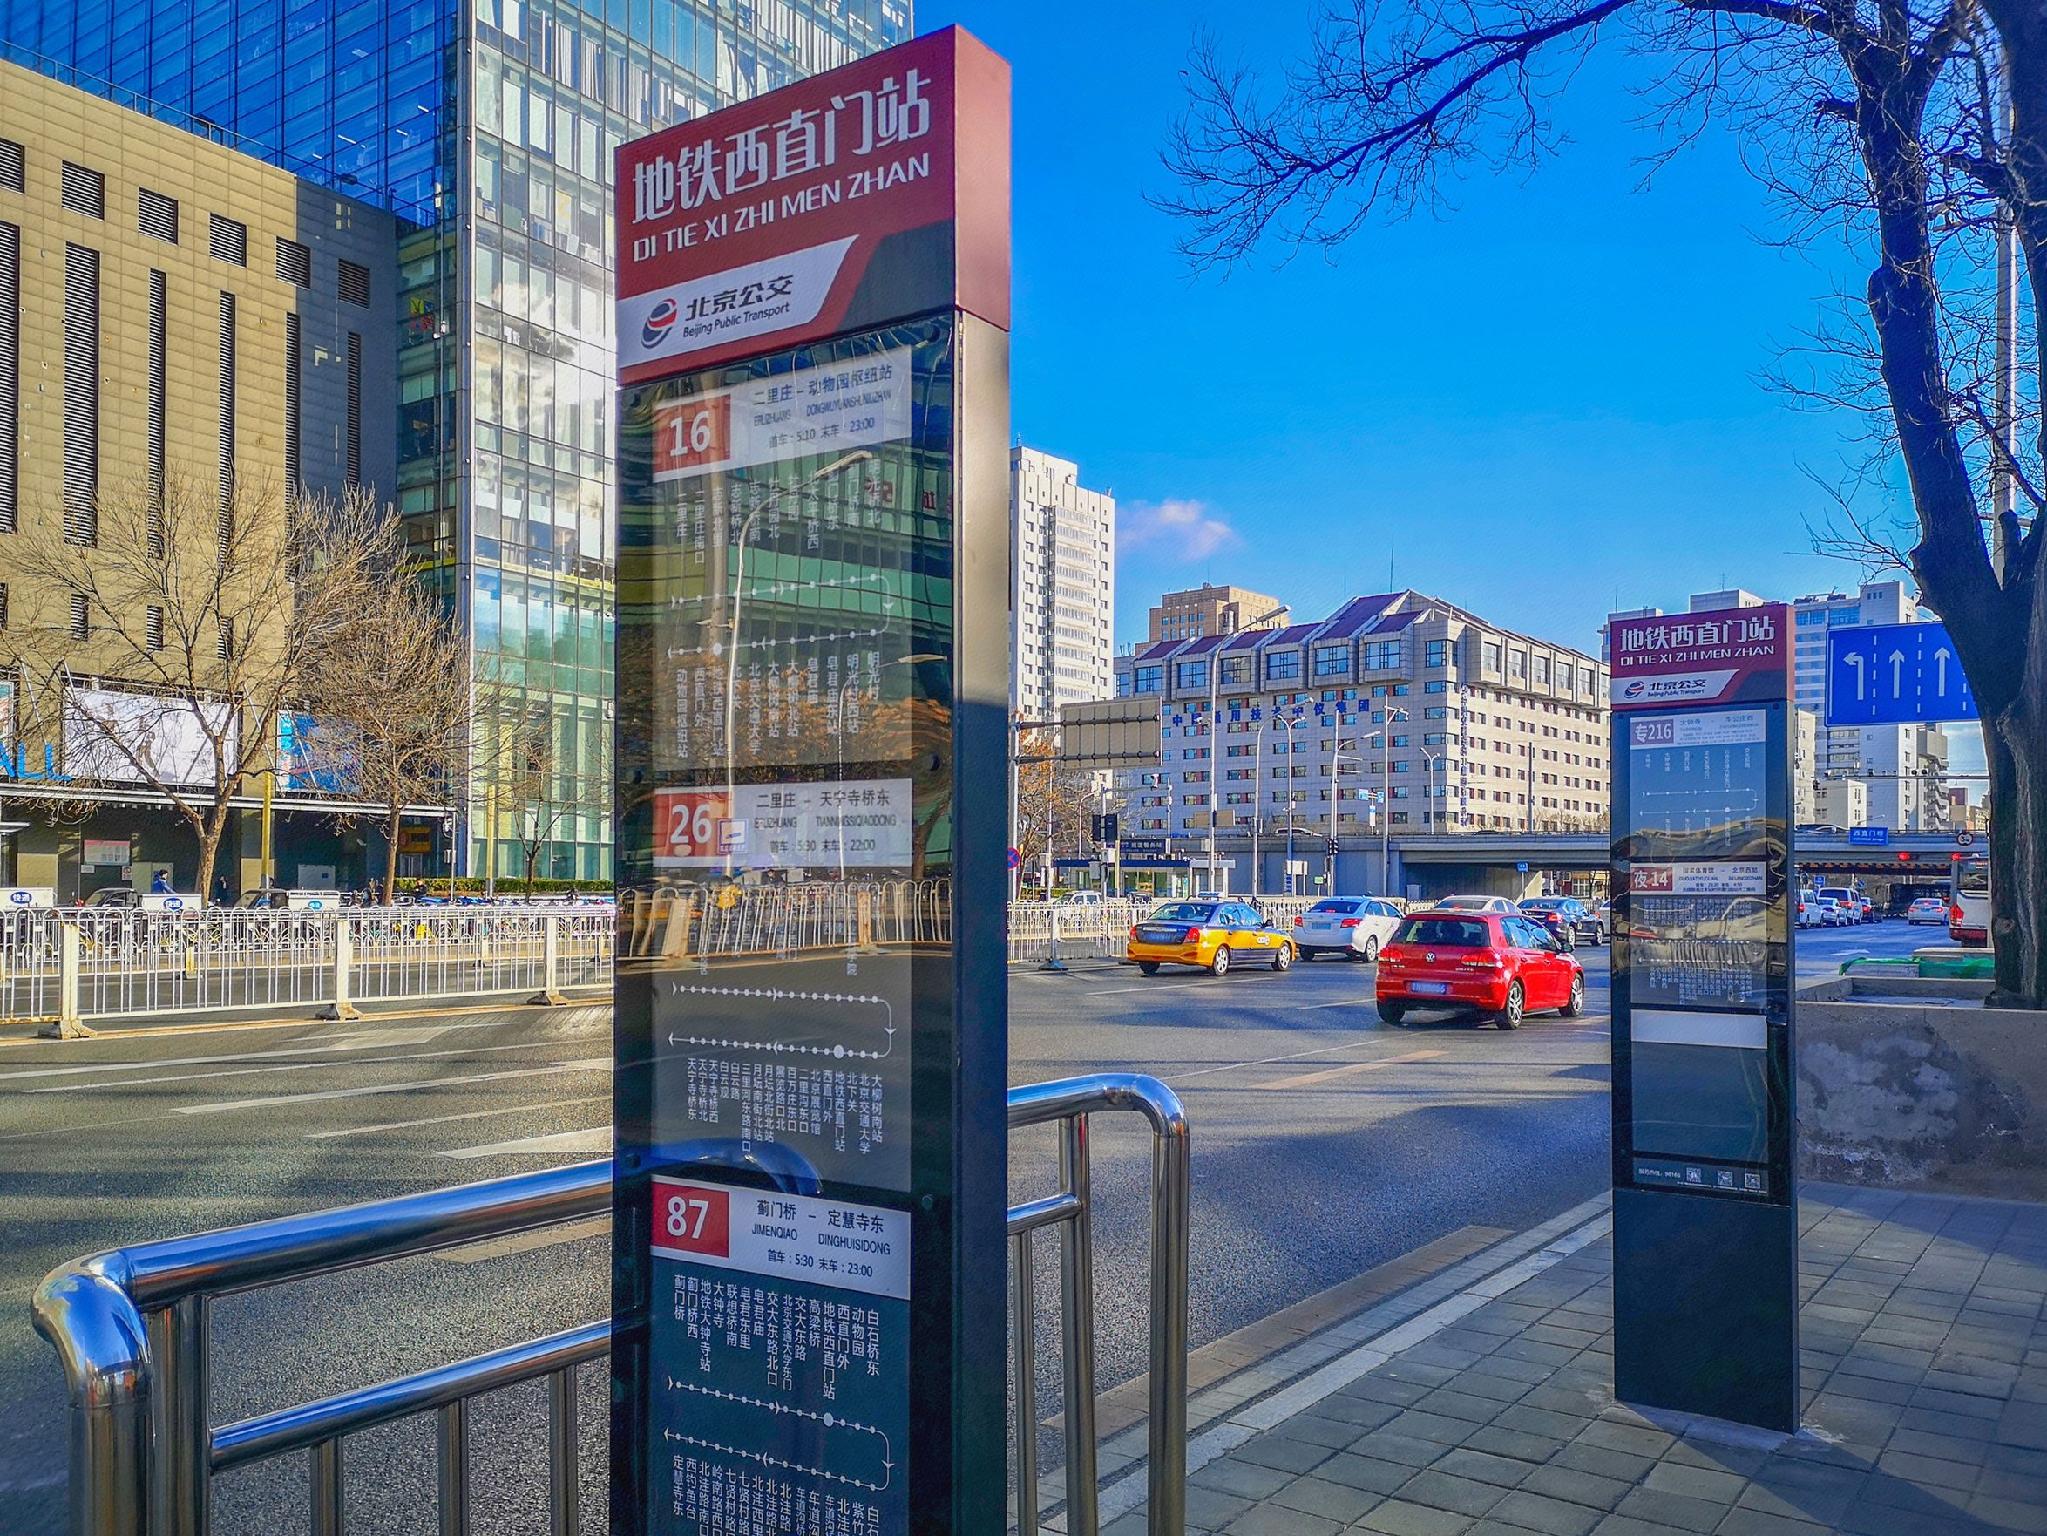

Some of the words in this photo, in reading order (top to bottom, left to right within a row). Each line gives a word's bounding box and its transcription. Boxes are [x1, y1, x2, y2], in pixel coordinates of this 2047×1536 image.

[632, 69, 931, 224] 地铁西直门站
[634, 238, 656, 262] DI
[663, 223, 698, 251] TIE
[704, 212, 727, 240] XI
[735, 197, 774, 232] ZHI
[782, 180, 840, 218] MEN
[848, 153, 929, 196] ZHAN
[683, 316, 712, 338] Beijing
[714, 308, 741, 330] Public
[743, 302, 790, 324] Transport
[685, 274, 794, 322] 北京公交
[754, 383, 793, 406] 二里庄
[669, 411, 711, 457] 16
[1620, 615, 1776, 653] 地铁西直门站
[1621, 656, 1633, 667] DI
[1637, 654, 1657, 665] TIE
[1660, 653, 1672, 663] XI
[1676, 651, 1698, 662] ZHI
[1700, 648, 1731, 661] MEN
[1734, 645, 1775, 658] ZHAN
[1650, 679, 1707, 691] 北京公交
[1635, 723, 1672, 743] 专216
[757, 792, 796, 808] 二里庄
[820, 788, 890, 807] 天宁寺桥东
[670, 804, 712, 844] 26
[1634, 871, 1668, 888] 夜14
[688, 1057, 698, 1121] 天宁寺桥东
[698, 1058, 709, 1122] 天宁寺桥北
[708, 1060, 719, 1124] 天宁寺桥西
[719, 1061, 729, 1099] 白云观
[730, 1061, 740, 1101] 白云路
[787, 1066, 797, 1133] 百万庄东口
[810, 1068, 821, 1136] 北京展览馆
[823, 1069, 833, 1124] 西直门外
[847, 1071, 858, 1113] 北下关
[834, 1070, 846, 1152] 地铁西直门站
[858, 1072, 871, 1155] 北京交通大学
[871, 1073, 883, 1144] 大柳树南站
[667, 1196, 709, 1239] 87
[752, 1223, 797, 1241] JIMENQIAO
[818, 1233, 891, 1255] DINGHUISIDONG
[757, 1200, 796, 1221] 蓟门桥
[828, 1210, 884, 1234] 定慧寺东
[674, 1274, 686, 1321] 蓟门桥
[687, 1276, 699, 1339] 蓟门桥西
[713, 1280, 725, 1329] 大钟寺
[726, 1283, 738, 1347] 联想桥南
[753, 1288, 765, 1337] 皂君庙
[699, 1279, 712, 1373] 地铁大钟寺站
[766, 1291, 779, 1388] 交大东路北口
[782, 1294, 793, 1392] 北京交通大学东门
[794, 1295, 806, 1362] 交大东路
[823, 1300, 836, 1400] 地铁西直门站
[836, 1302, 850, 1370] 西直门外
[851, 1306, 865, 1357] 动物园
[866, 1308, 880, 1377] 白石桥东
[780, 1481, 792, 1533] 北洼路
